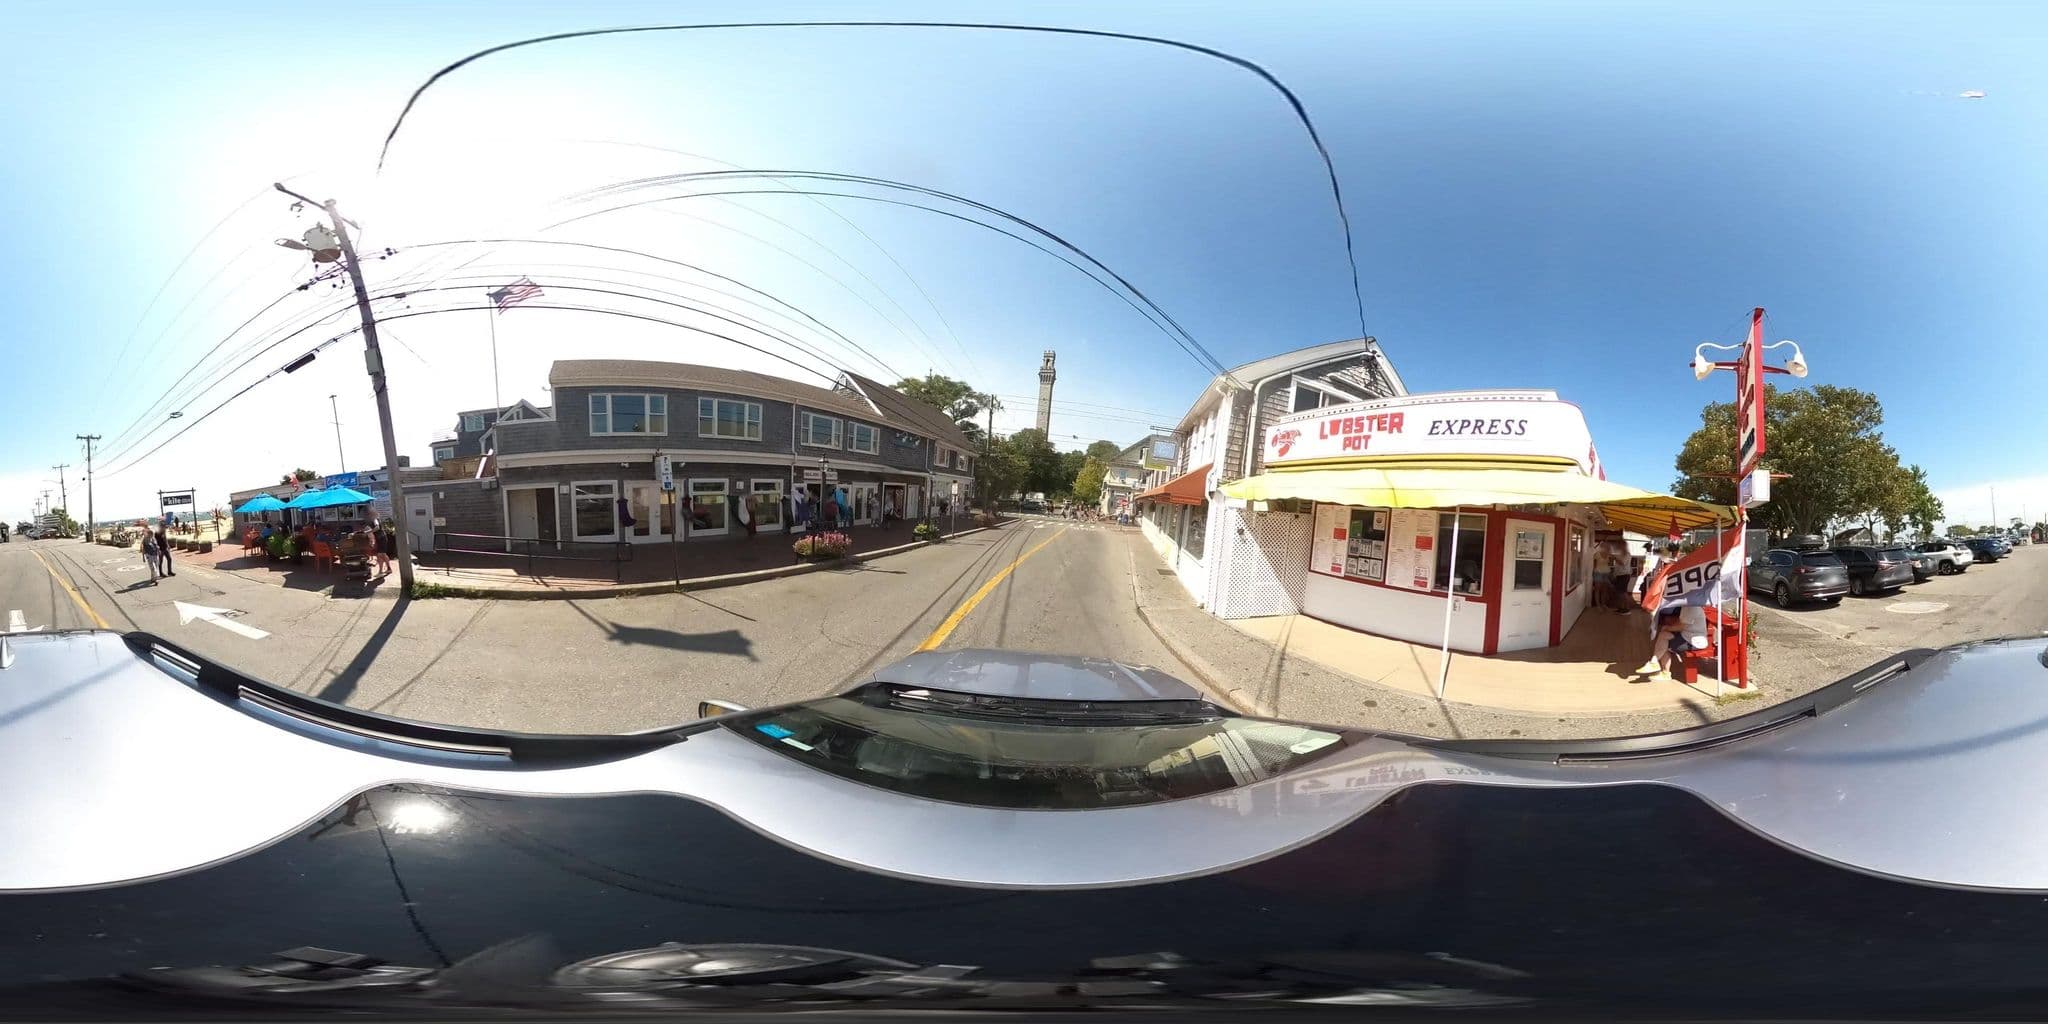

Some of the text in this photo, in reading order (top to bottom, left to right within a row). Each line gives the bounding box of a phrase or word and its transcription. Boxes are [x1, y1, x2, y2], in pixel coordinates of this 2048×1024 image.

[1319, 412, 1404, 440] LOBSTER
[1427, 419, 1529, 437] EXPRESS
[1342, 434, 1371, 451] POT
